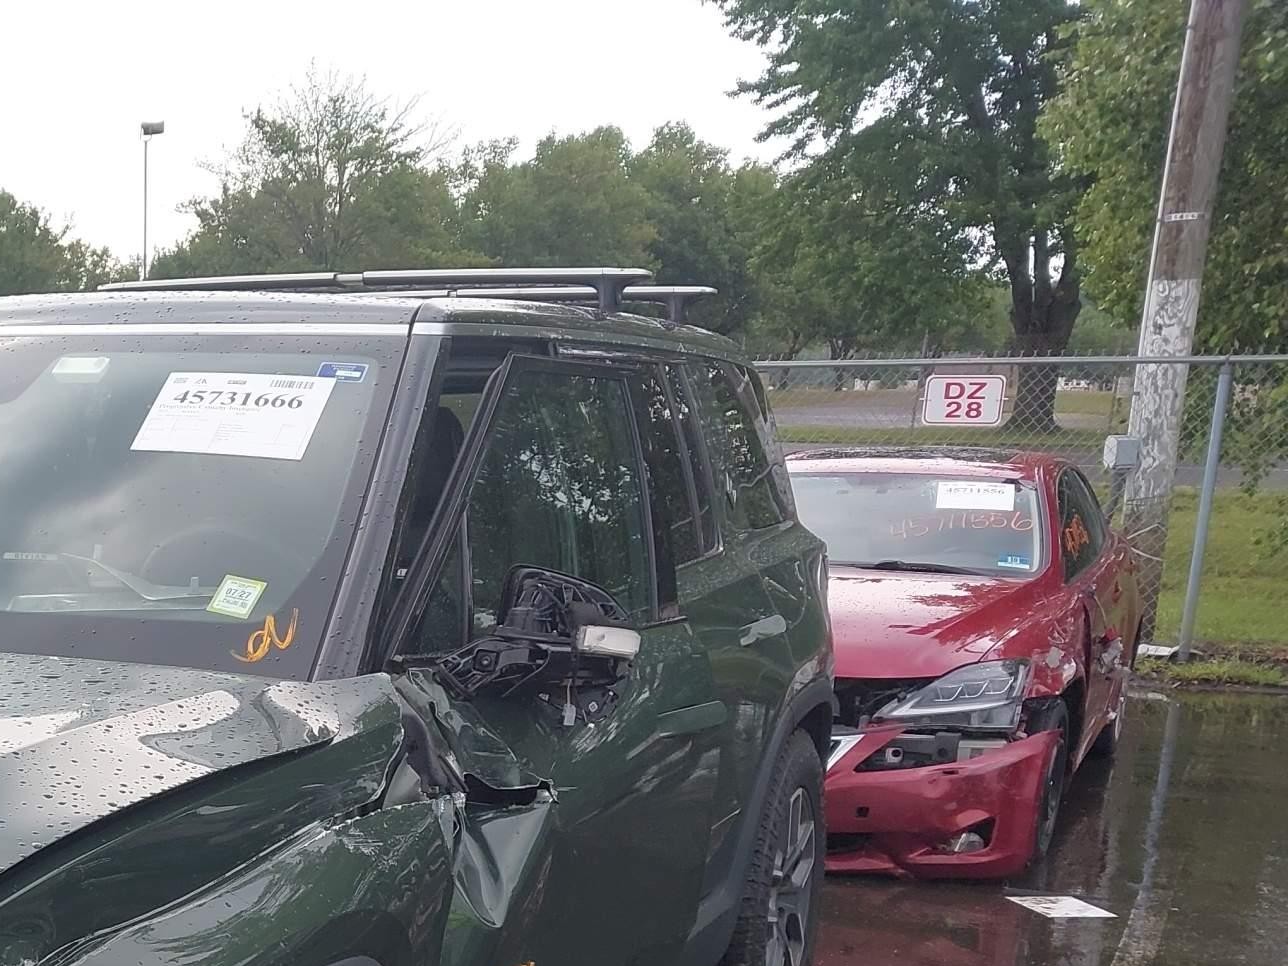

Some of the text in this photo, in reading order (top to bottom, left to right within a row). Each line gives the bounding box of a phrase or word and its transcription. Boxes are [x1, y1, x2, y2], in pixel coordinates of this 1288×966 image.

[173, 390, 304, 409] 45731666
[944, 381, 988, 400] DZ
[945, 401, 983, 419] 28
